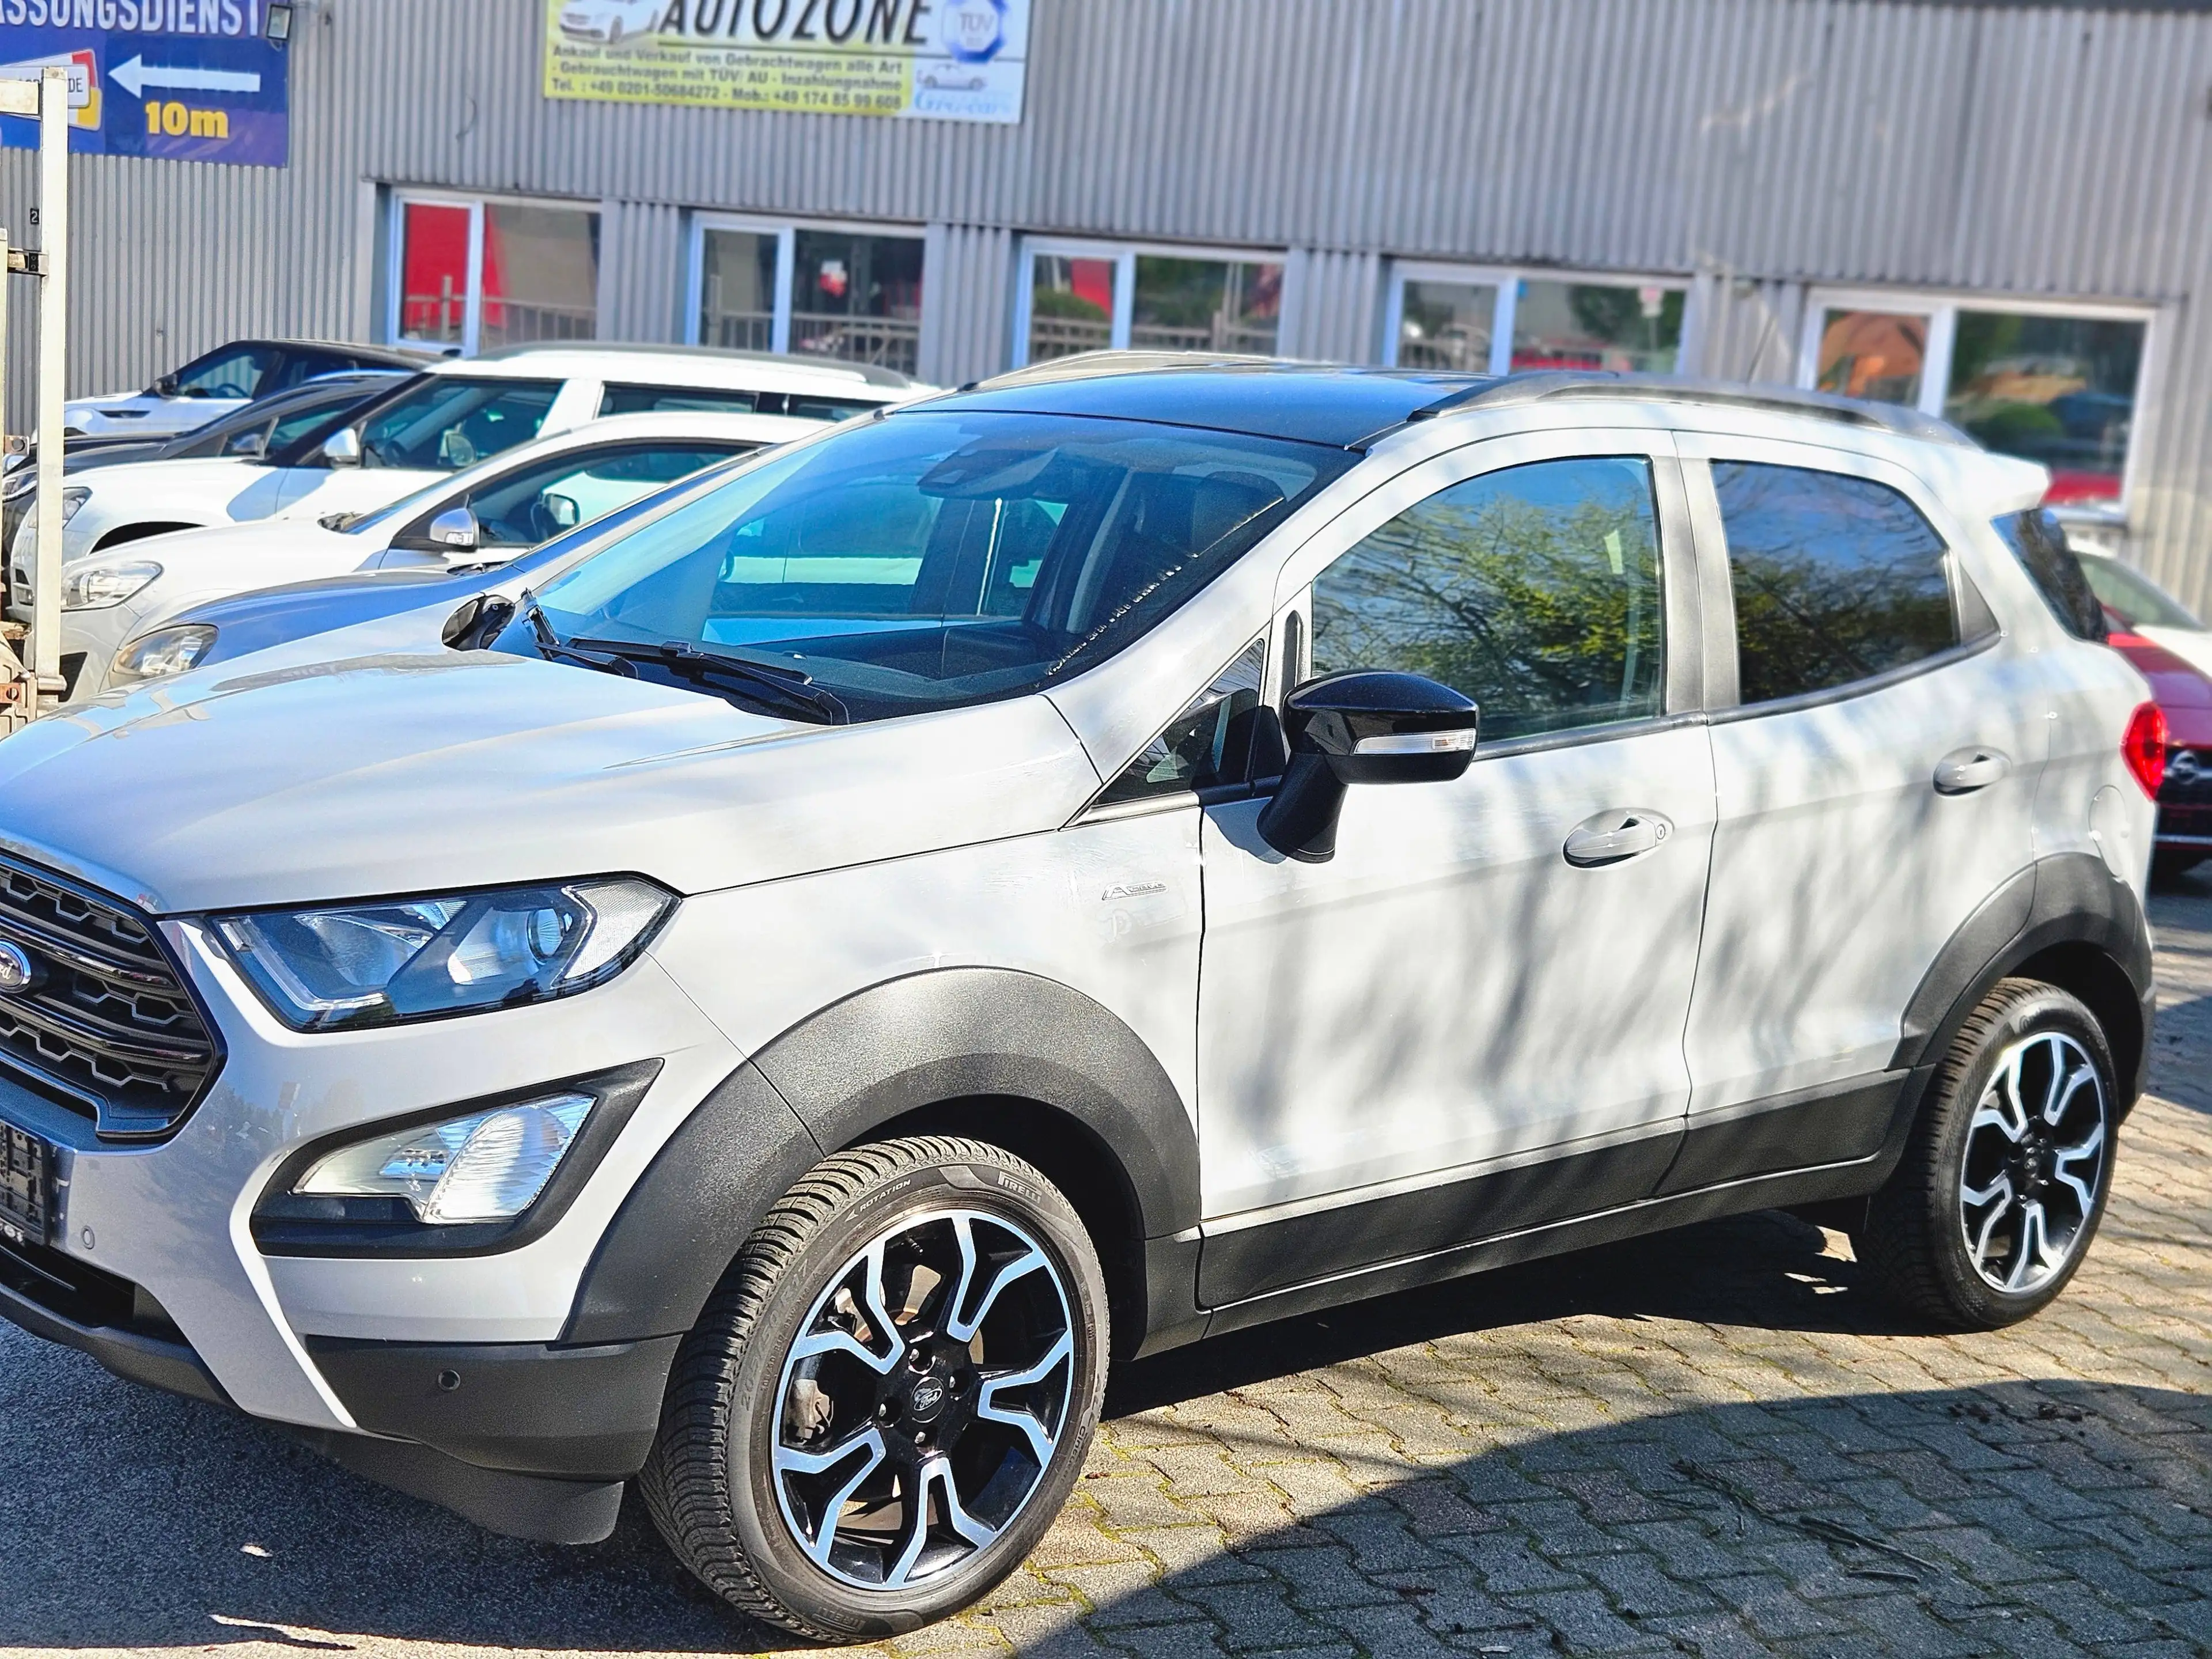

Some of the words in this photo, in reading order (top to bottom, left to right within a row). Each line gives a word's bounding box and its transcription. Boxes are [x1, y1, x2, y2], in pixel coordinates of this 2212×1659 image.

[0, 0, 257, 36] SSUNGSDIENST
[553, 45, 600, 58] Ankauf
[605, 49, 631, 61] und
[636, 49, 691, 63] Verkauf
[696, 54, 721, 65] von
[879, 60, 902, 74] Art
[682, 69, 704, 81] mit
[747, 70, 768, 84] AU
[803, 90, 828, 105] 174
[145, 101, 229, 138] 10m
[31, 211, 39, 223] 2
[859, 1179, 911, 1212] ROTATION
[997, 1170, 1042, 1204] PIRELLI
[919, 1391, 938, 1409] Ford
